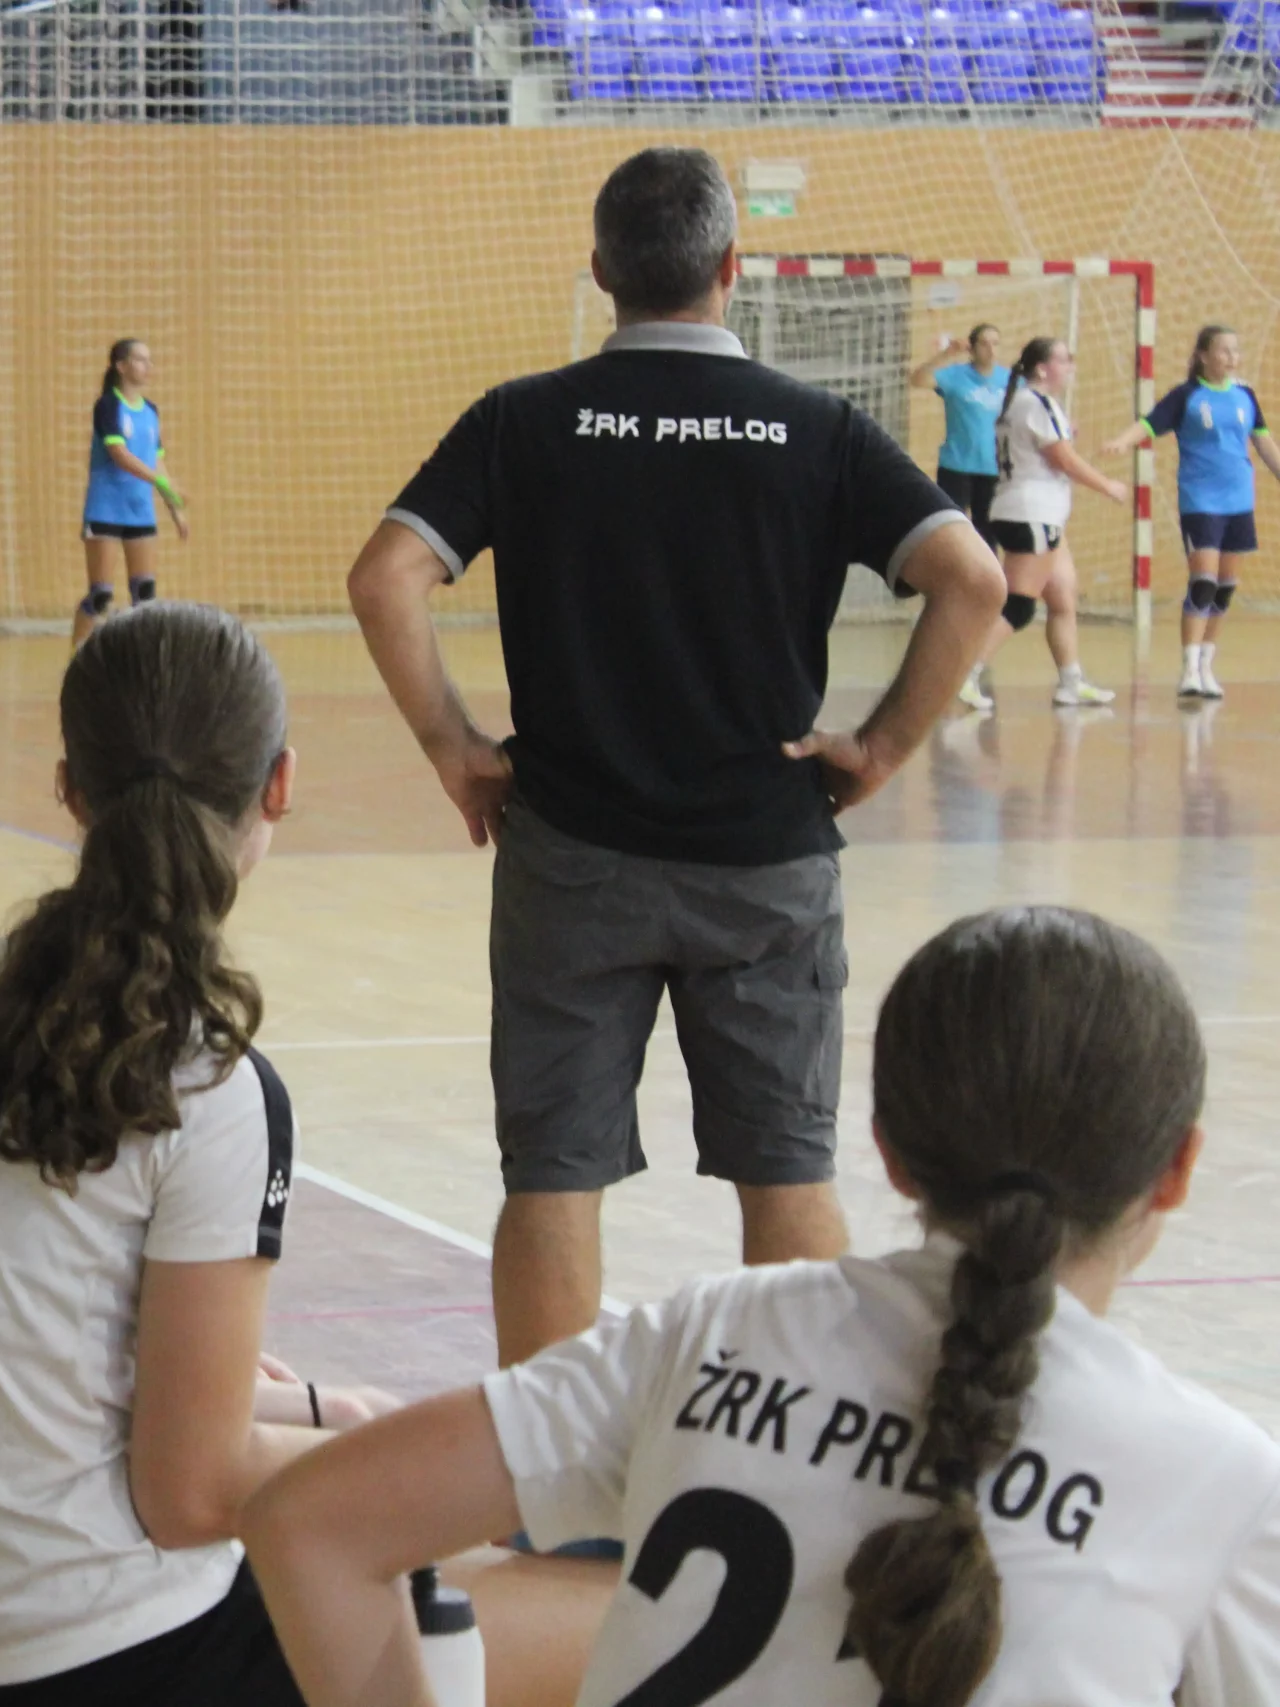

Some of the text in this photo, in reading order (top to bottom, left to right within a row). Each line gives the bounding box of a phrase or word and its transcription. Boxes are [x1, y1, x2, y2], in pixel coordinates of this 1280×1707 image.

[575, 408, 788, 445] ŽRK PRELOG
[675, 1350, 1105, 1553] ŽRK PREOG
